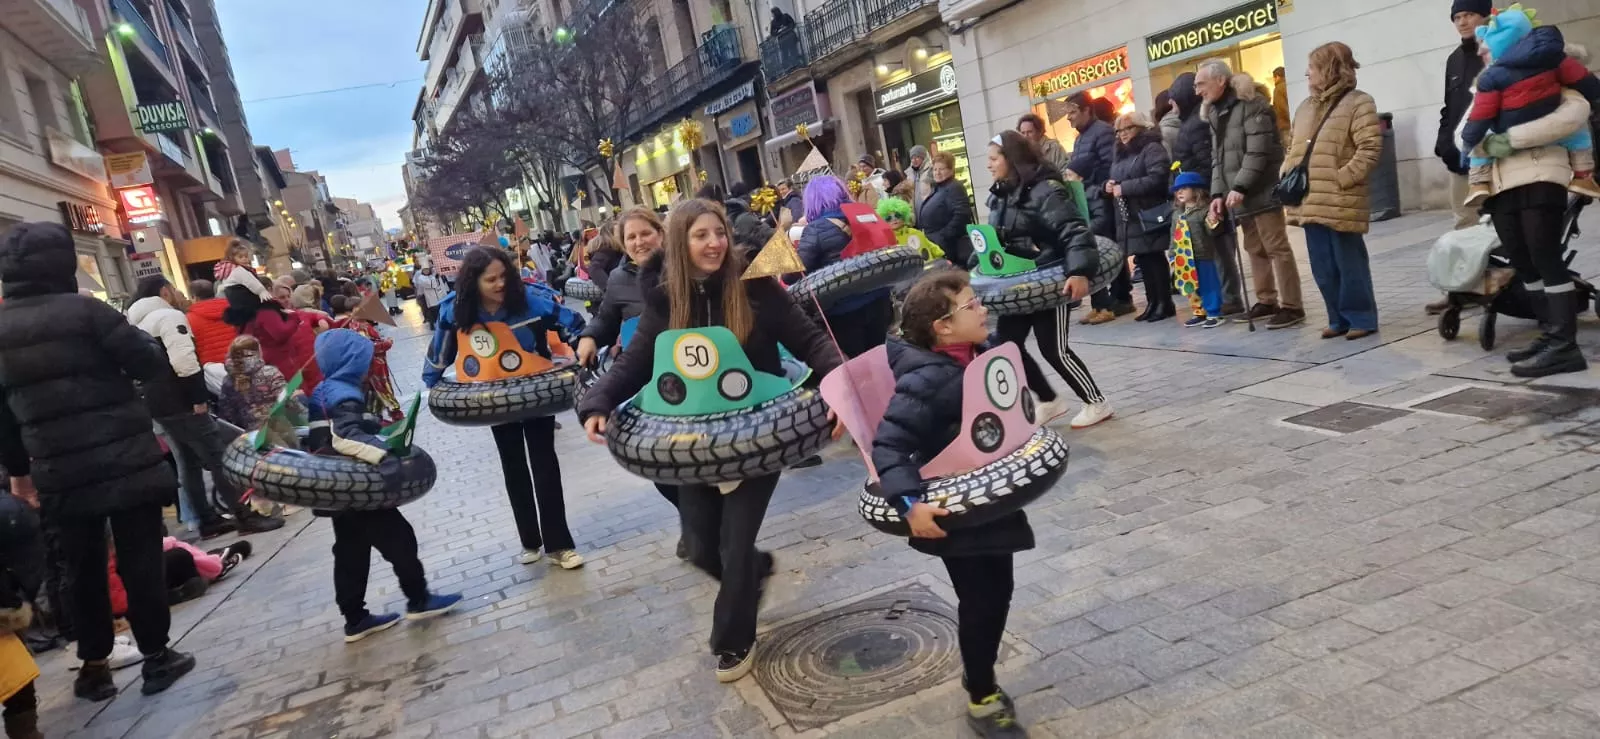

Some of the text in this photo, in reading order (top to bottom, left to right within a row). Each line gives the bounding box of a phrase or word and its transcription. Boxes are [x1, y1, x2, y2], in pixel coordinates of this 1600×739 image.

[1148, 3, 1275, 60] women'secret
[138, 102, 186, 125] DUVISA
[145, 121, 187, 131] ASESORES
[473, 335, 490, 350] 54
[684, 345, 710, 367] 50
[996, 369, 1009, 395] 8
